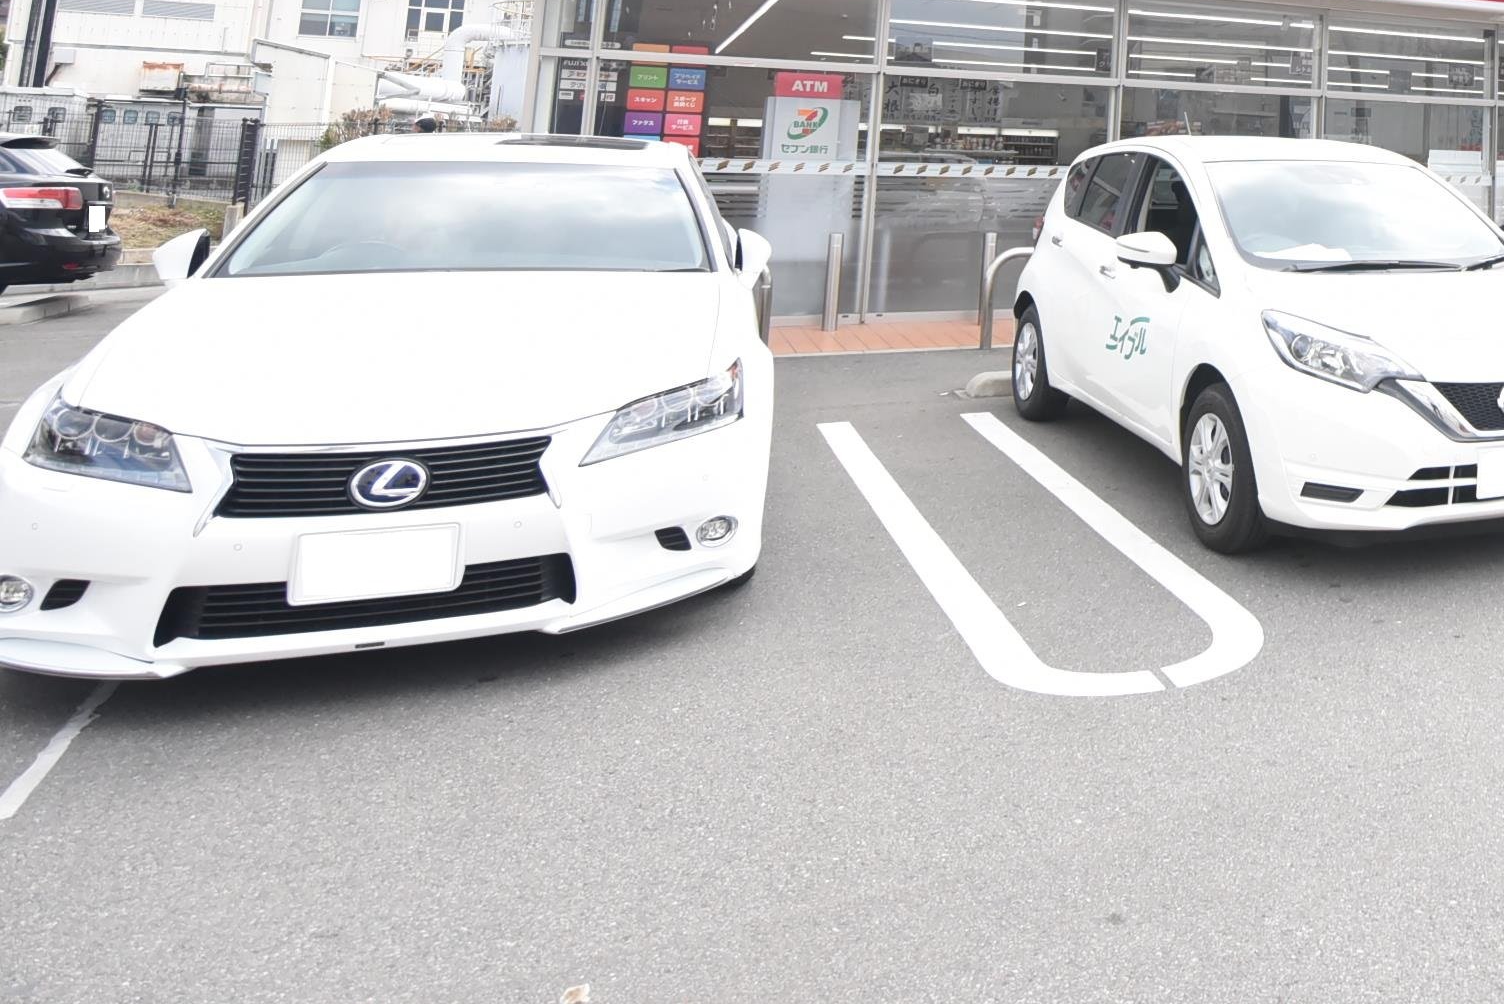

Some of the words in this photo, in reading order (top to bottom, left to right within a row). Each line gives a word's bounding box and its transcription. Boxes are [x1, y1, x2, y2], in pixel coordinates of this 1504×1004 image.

[792, 80, 829, 93] ATM
[793, 120, 819, 128] BANK
[781, 144, 829, 154] セブン銀行
